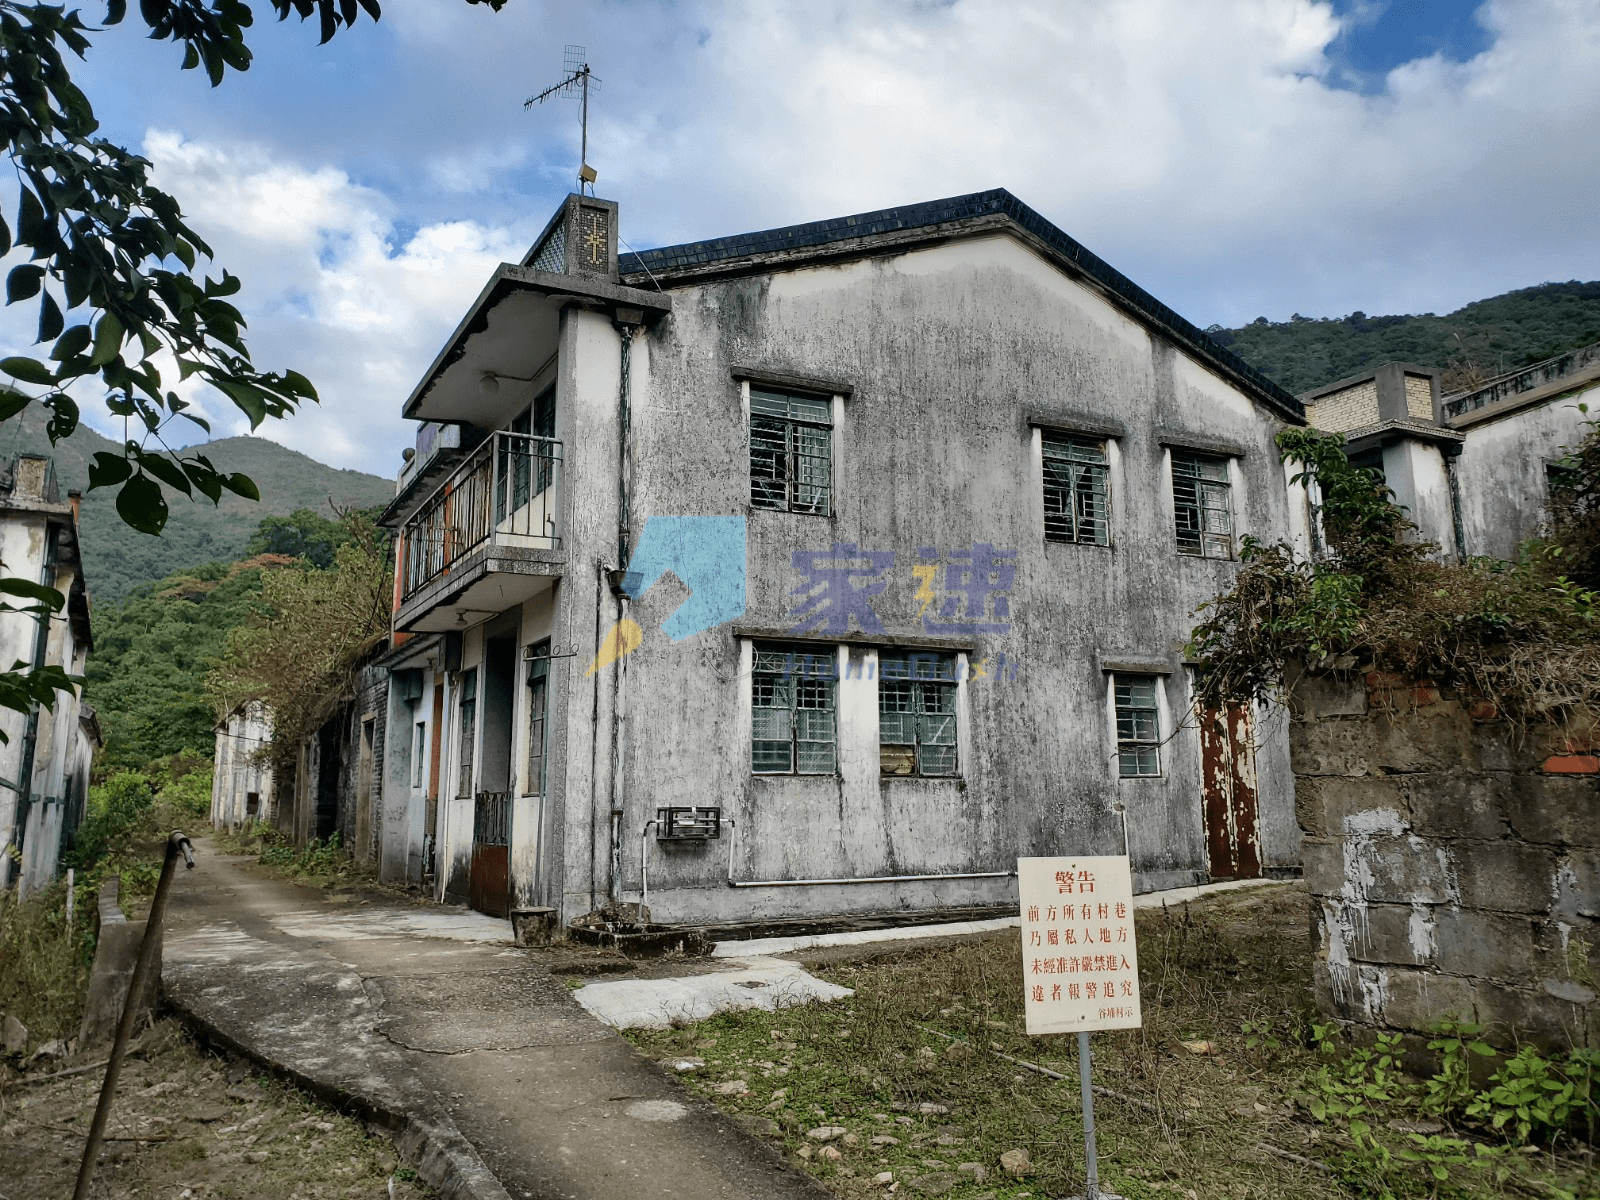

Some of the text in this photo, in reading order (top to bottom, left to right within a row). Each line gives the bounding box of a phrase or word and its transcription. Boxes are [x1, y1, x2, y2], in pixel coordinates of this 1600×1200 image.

[1055, 870, 1095, 894] 警告
[1027, 902, 1127, 922] 前方所有村巷
[1029, 926, 1128, 947] 乃屬私人地方
[1031, 954, 1131, 975] 未經准許嚴禁進入
[1031, 980, 1133, 1002] 違者報警追究
